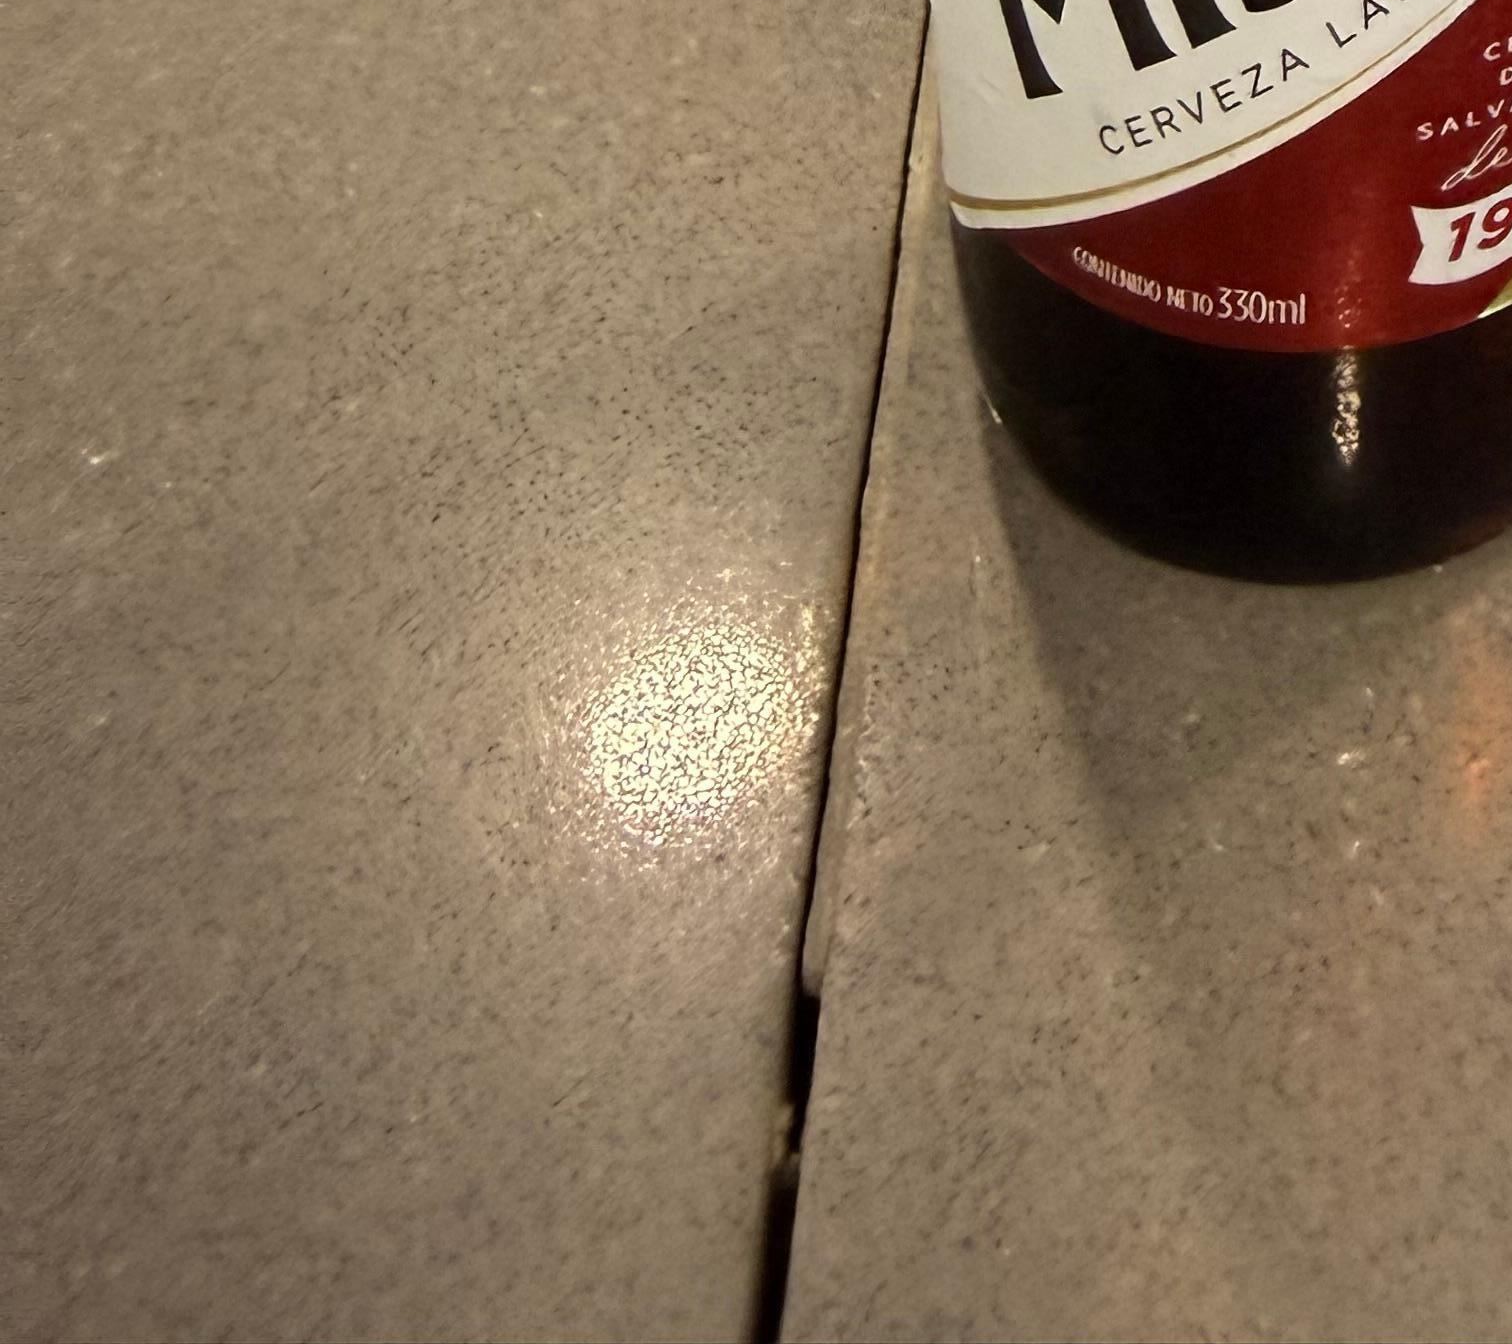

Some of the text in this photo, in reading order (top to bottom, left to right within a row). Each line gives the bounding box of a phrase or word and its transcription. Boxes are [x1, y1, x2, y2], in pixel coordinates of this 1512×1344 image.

[1099, 47, 1310, 156] CERVEZA
[1072, 246, 1162, 303] CONTENIDO
[1215, 286, 1307, 326] 330ml
